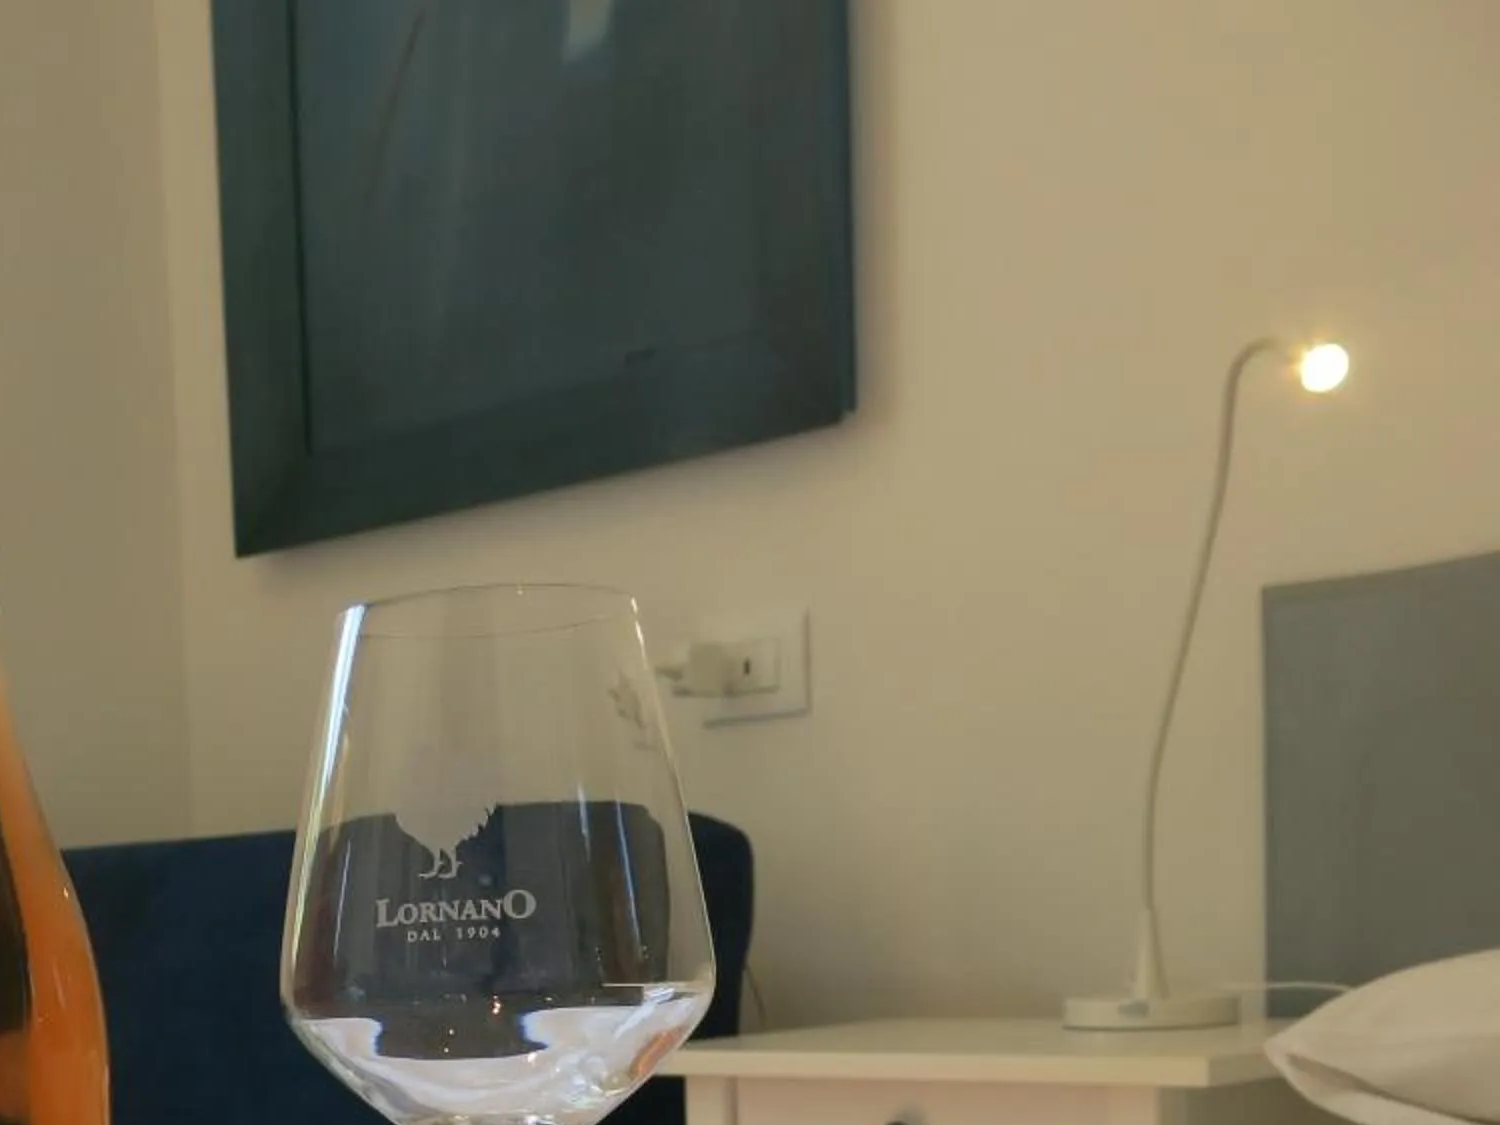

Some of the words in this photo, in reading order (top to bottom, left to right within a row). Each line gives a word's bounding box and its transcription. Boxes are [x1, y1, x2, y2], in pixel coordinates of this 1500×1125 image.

[375, 889, 537, 928] LORNANO
[407, 928, 441, 943] DAL
[456, 926, 501, 941] 1904
